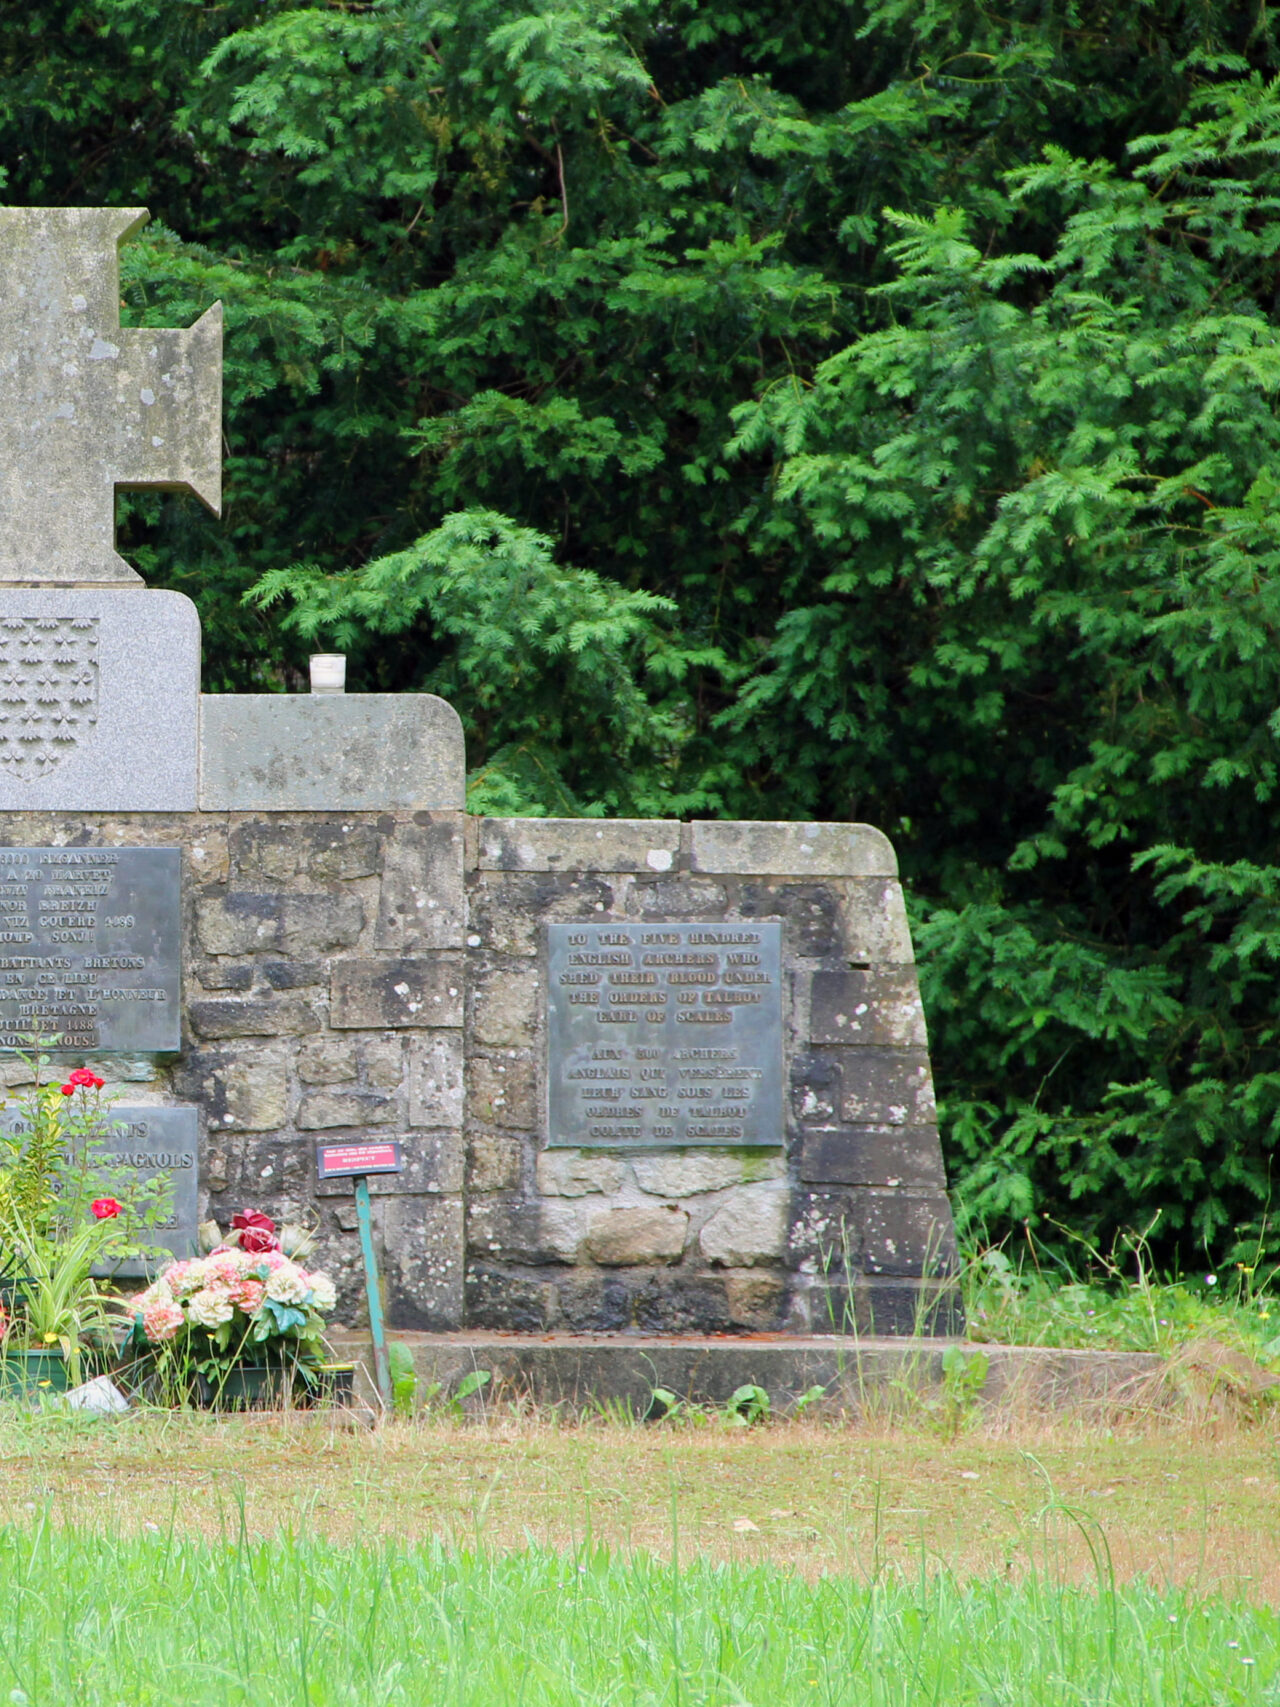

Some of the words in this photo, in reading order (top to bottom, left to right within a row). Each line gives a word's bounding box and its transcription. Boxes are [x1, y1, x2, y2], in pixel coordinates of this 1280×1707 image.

[7, 869, 18, 881] A
[38, 900, 97, 912] BREIZH
[3, 915, 30, 928] VIZ
[568, 933, 588, 945] TO
[598, 933, 629, 945] THE
[641, 933, 680, 945] FIVE
[689, 933, 761, 945] HUNDRED
[83, 957, 145, 970] BRETONS
[568, 953, 631, 965] ENGLISH
[643, 953, 715, 965] ARCHERS
[727, 953, 760, 965] WHO
[5, 973, 24, 985] EN
[37, 973, 55, 985] CE
[64, 973, 98, 985] LIEU
[559, 973, 599, 984] SHED
[609, 973, 656, 984] THEIR
[668, 973, 716, 984] BLOOD
[724, 973, 772, 984] UNDER
[56, 989, 76, 1001] ET
[87, 989, 168, 1001] L'HONNEUR
[569, 992, 600, 1004] THE
[608, 992, 667, 1004] ORDERS
[677, 992, 697, 1004] OF
[704, 992, 762, 1004] TALBOT
[19, 1005, 98, 1017] BRETAGNE
[597, 1011, 638, 1023] EARL
[646, 1011, 665, 1023] OF
[676, 1011, 732, 1023] SCALES
[65, 1020, 94, 1032] 1488
[591, 1048, 623, 1060] AUX
[635, 1048, 659, 1060] 500
[672, 1048, 738, 1060] ARCHERS
[567, 1068, 631, 1080] ANGLAIS
[639, 1068, 666, 1080] QUI
[581, 1087, 622, 1099] LEUR
[631, 1087, 667, 1099] SANG
[677, 1087, 712, 1099] SOUS
[722, 1087, 750, 1099] LES
[585, 1106, 642, 1118] ORDRES
[658, 1106, 679, 1118] DE
[688, 1106, 747, 1118] TALBOT
[589, 1125, 641, 1137] COMTE
[654, 1125, 673, 1137] DE
[686, 1125, 742, 1137] SCALES
